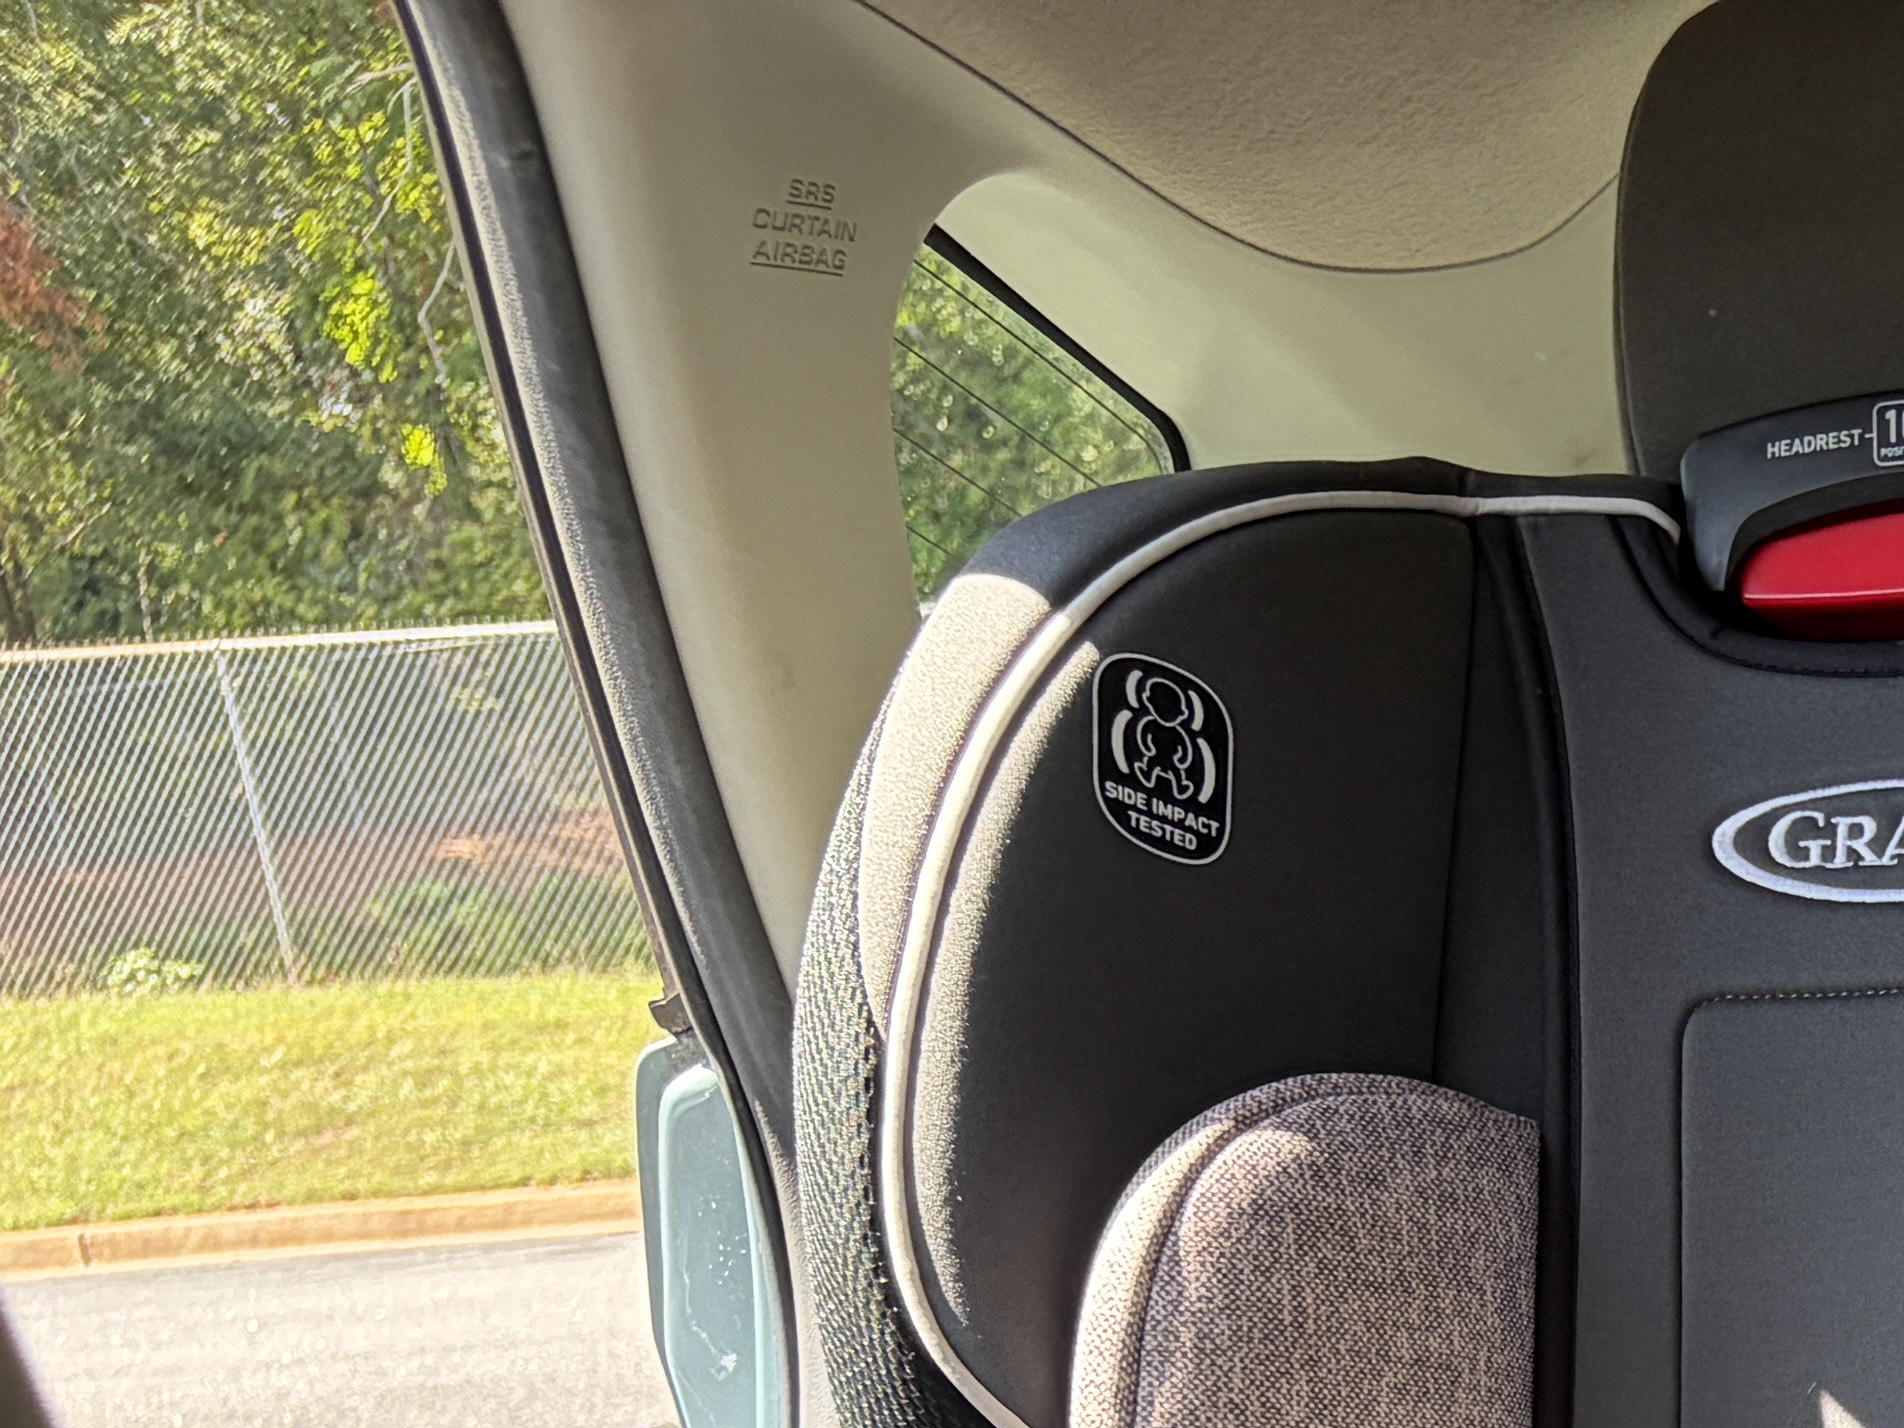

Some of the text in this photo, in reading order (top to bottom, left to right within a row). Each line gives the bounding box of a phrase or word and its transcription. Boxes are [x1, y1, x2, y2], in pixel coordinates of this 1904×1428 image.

[788, 178, 836, 204] SRS
[752, 208, 857, 242] CURTAIN
[752, 240, 847, 271] AIRBAG
[1766, 428, 1863, 459] HEADREST
[1105, 781, 1220, 837] SIDE IMPACT
[1128, 810, 1197, 851] TESTED
